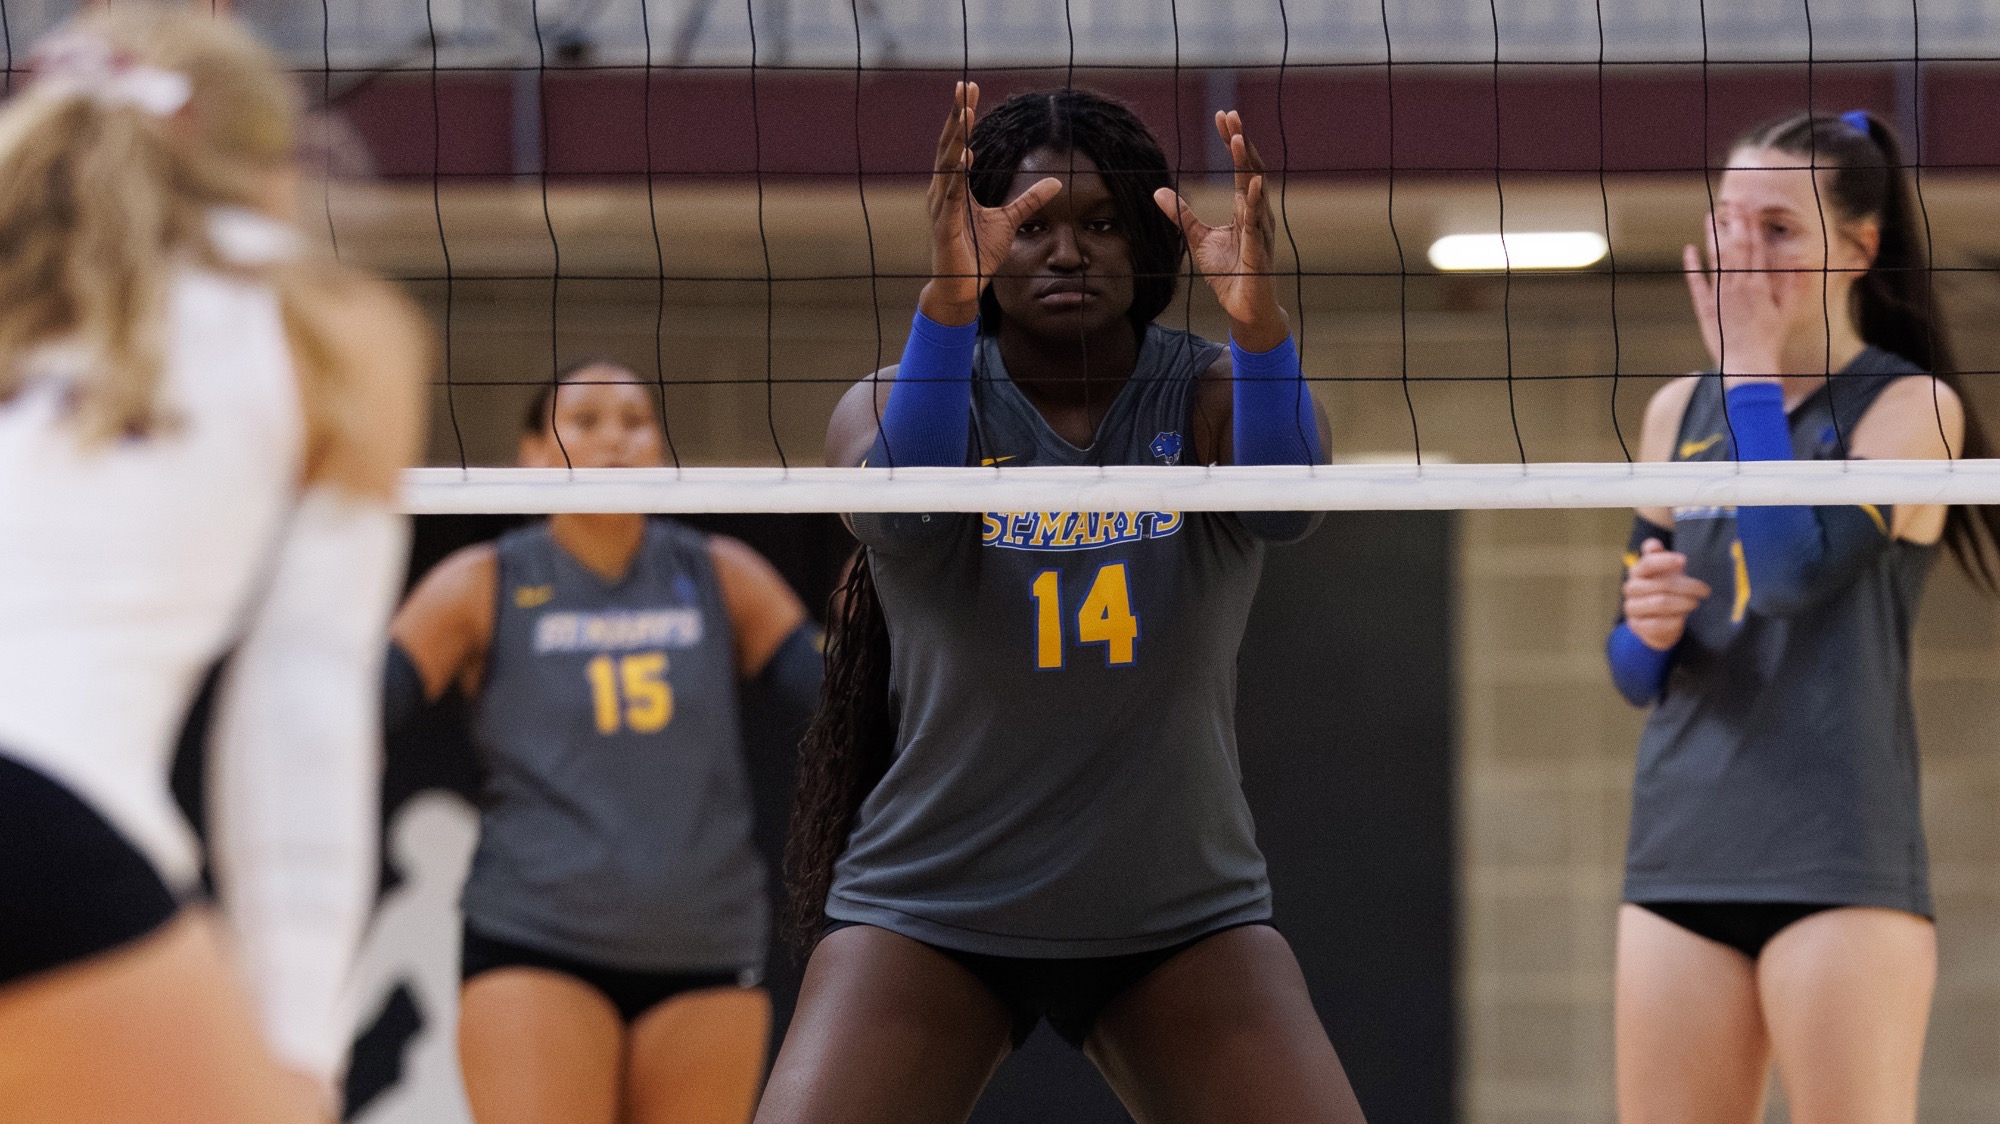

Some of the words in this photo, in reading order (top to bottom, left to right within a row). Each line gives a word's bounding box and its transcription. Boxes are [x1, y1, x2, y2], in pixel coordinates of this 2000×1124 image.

[982, 511, 1184, 548] ST.MARYS
[1031, 562, 1139, 669] 14
[587, 653, 674, 734] 15
